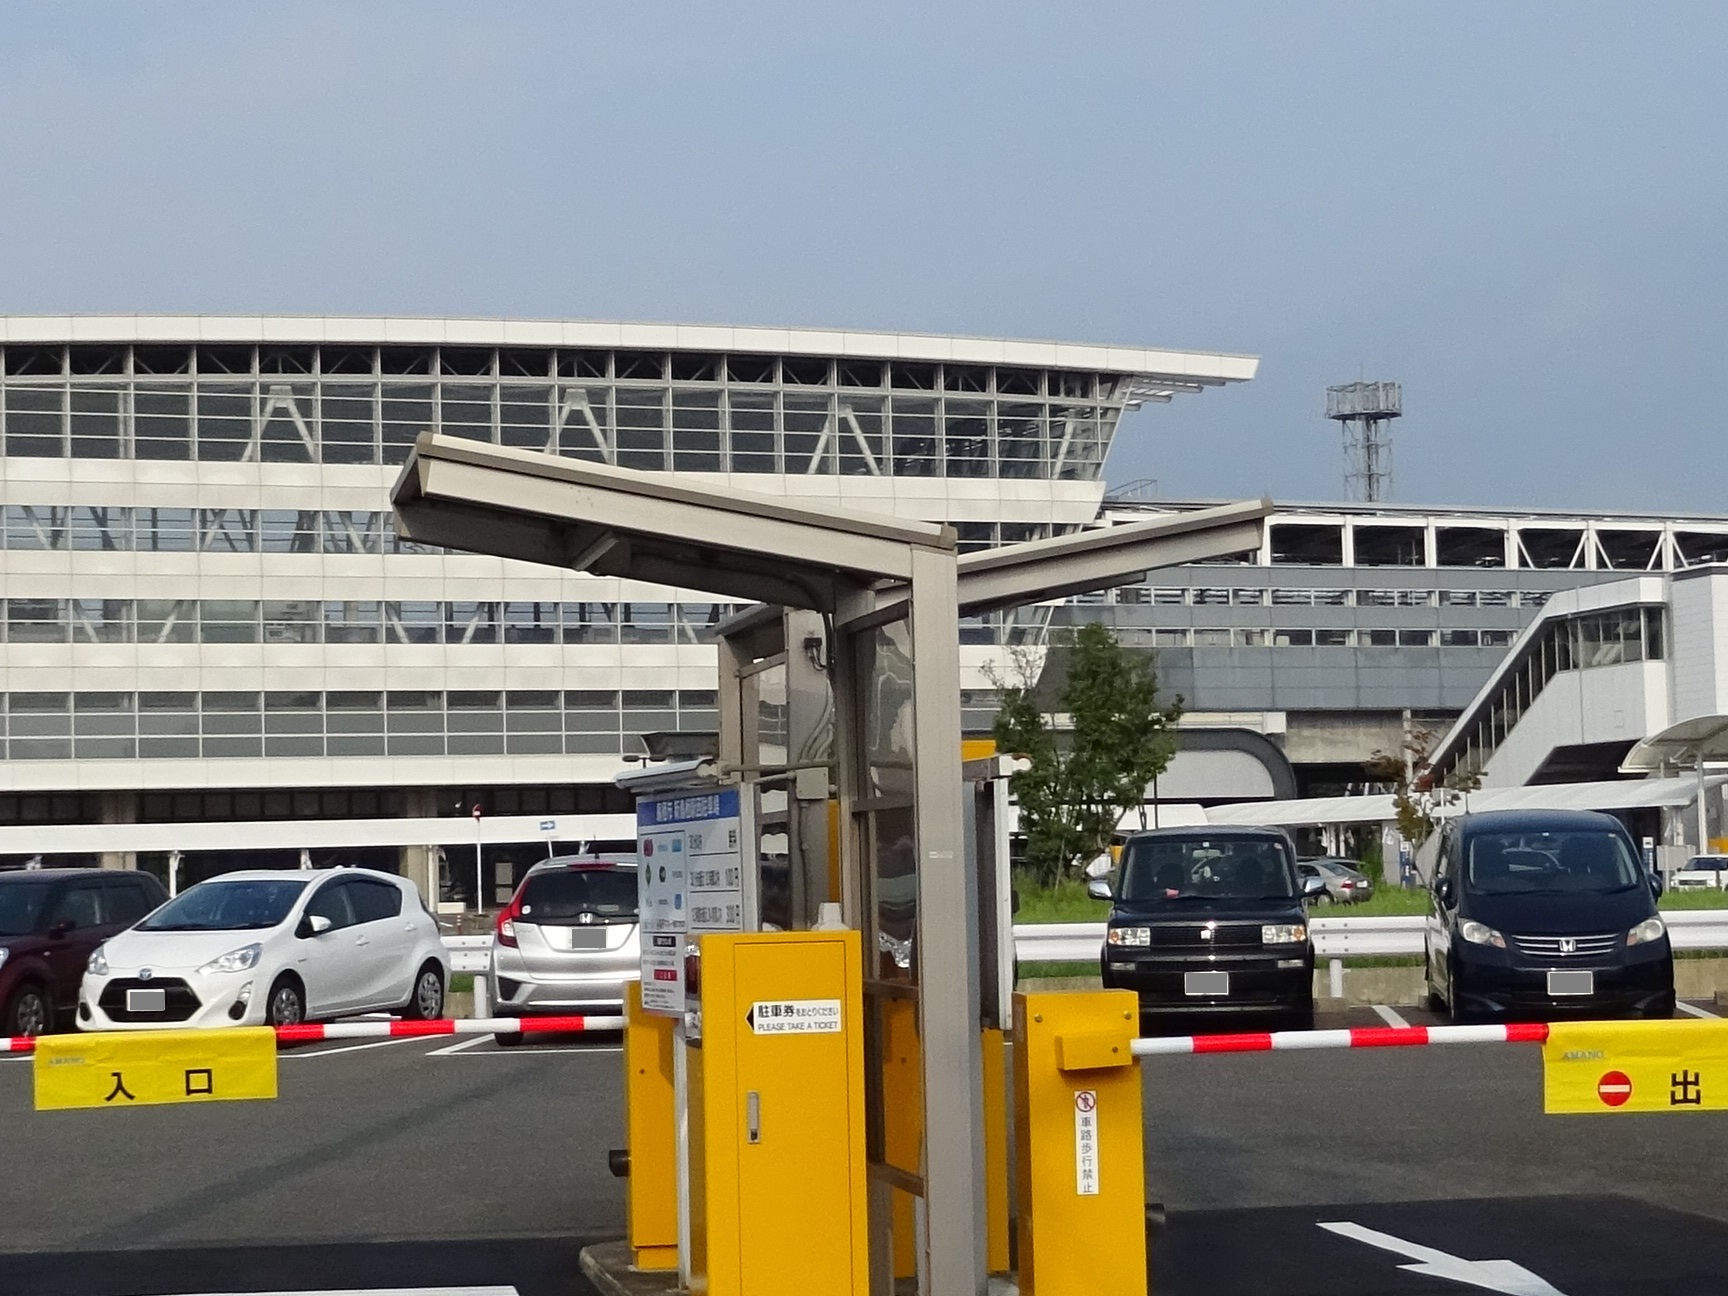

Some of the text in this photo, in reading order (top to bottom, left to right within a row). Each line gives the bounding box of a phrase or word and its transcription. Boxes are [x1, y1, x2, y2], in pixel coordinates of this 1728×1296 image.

[757, 1020, 838, 1032] PLEASE TAKE A TICKET
[104, 1068, 214, 1102] 入口
[1081, 1116, 1094, 1193] 車路歩行禁止
